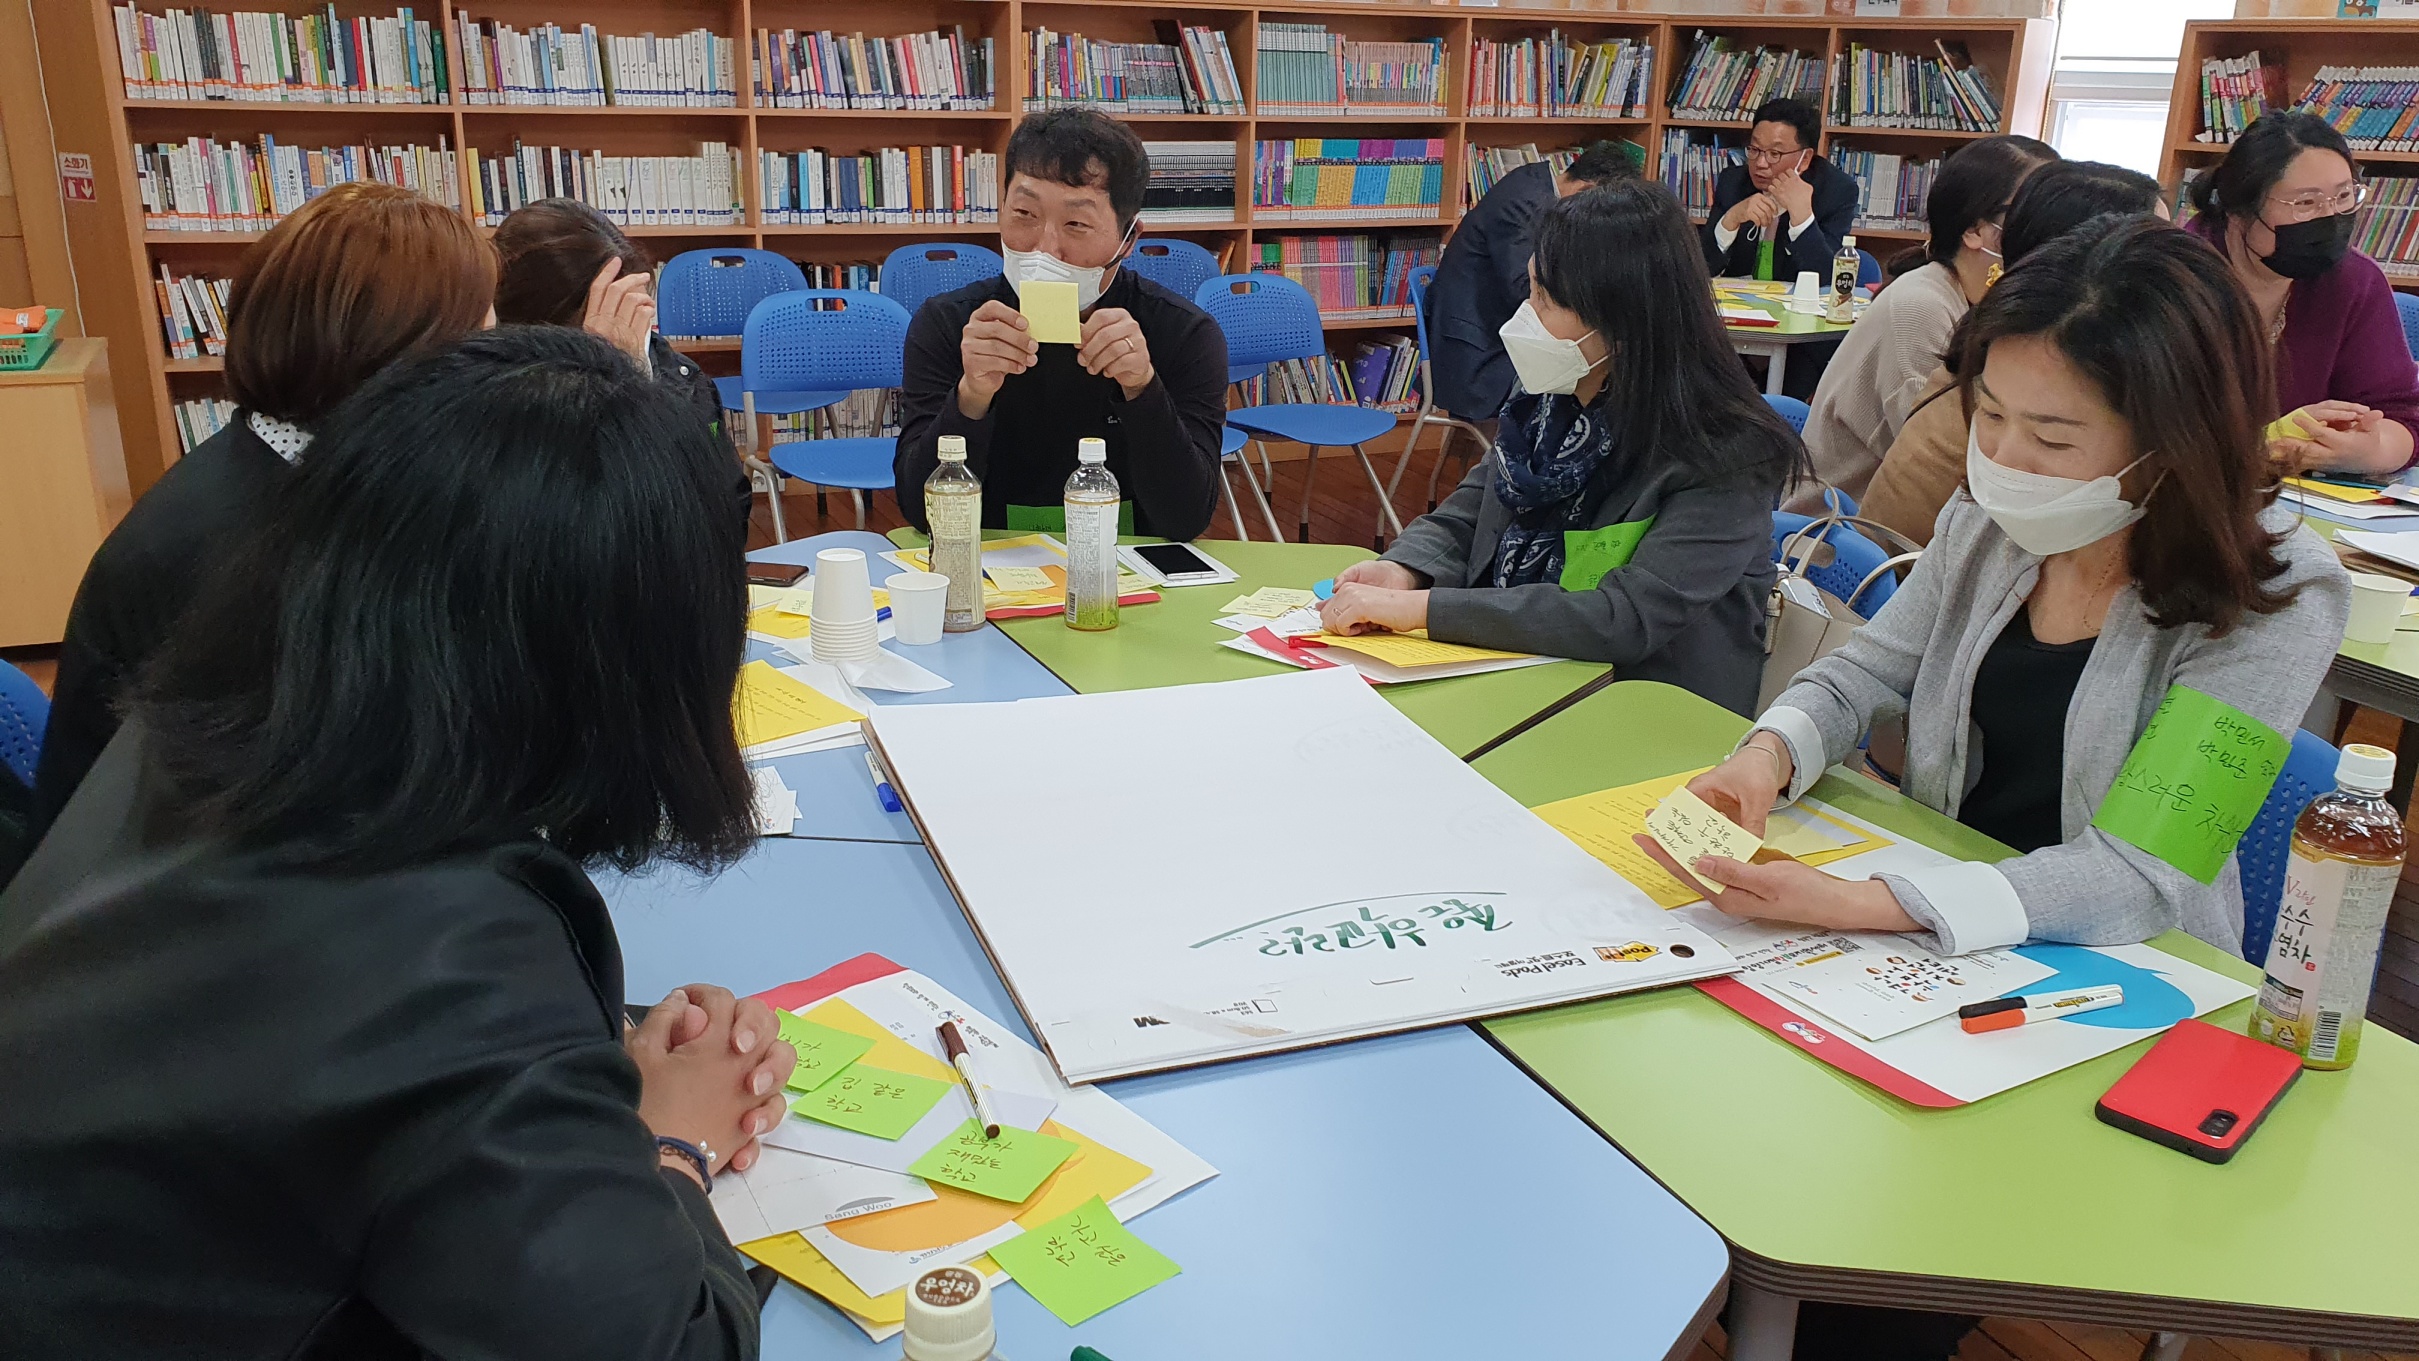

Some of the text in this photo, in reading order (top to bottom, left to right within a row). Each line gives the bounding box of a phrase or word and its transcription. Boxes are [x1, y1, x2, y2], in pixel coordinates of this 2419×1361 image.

[64, 156, 89, 170] 소화기
[1705, 815, 1732, 841] 학교
[2286, 874, 2316, 906] V라인
[1259, 898, 1514, 957] 좋은 학교란?
[2281, 905, 2314, 936] 수수
[2274, 932, 2311, 964] 염차
[1501, 957, 1586, 979] Easel Pads
[863, 1202, 892, 1212] Woo
[1046, 1235, 1075, 1266] 학교
